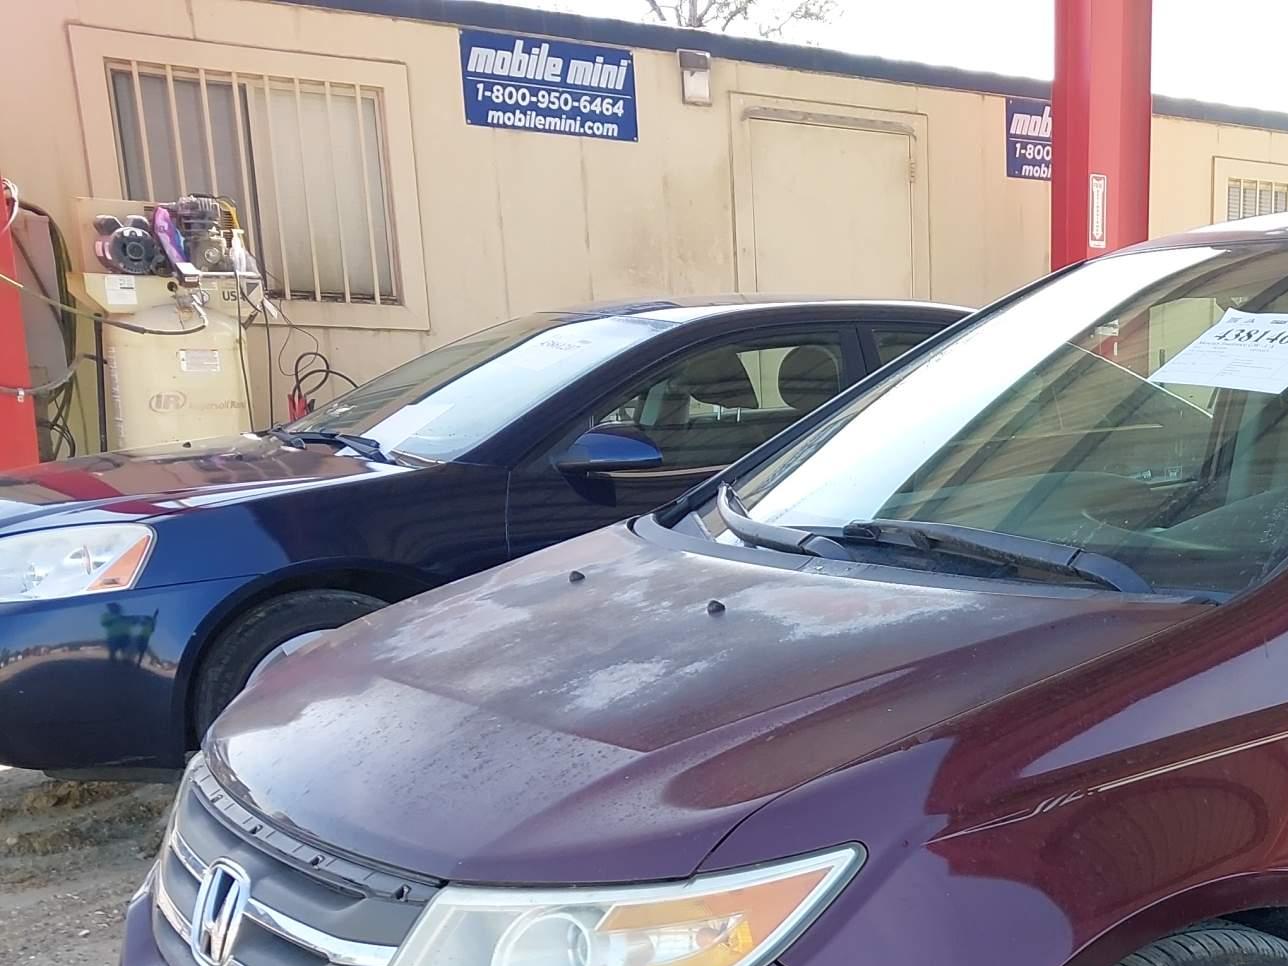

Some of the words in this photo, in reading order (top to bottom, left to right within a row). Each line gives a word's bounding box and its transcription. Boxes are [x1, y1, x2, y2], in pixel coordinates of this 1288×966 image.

[467, 39, 563, 82] mobile
[566, 56, 628, 90] mini
[476, 83, 624, 117] 1-800-950-6464
[487, 109, 618, 137] mobilemini.com
